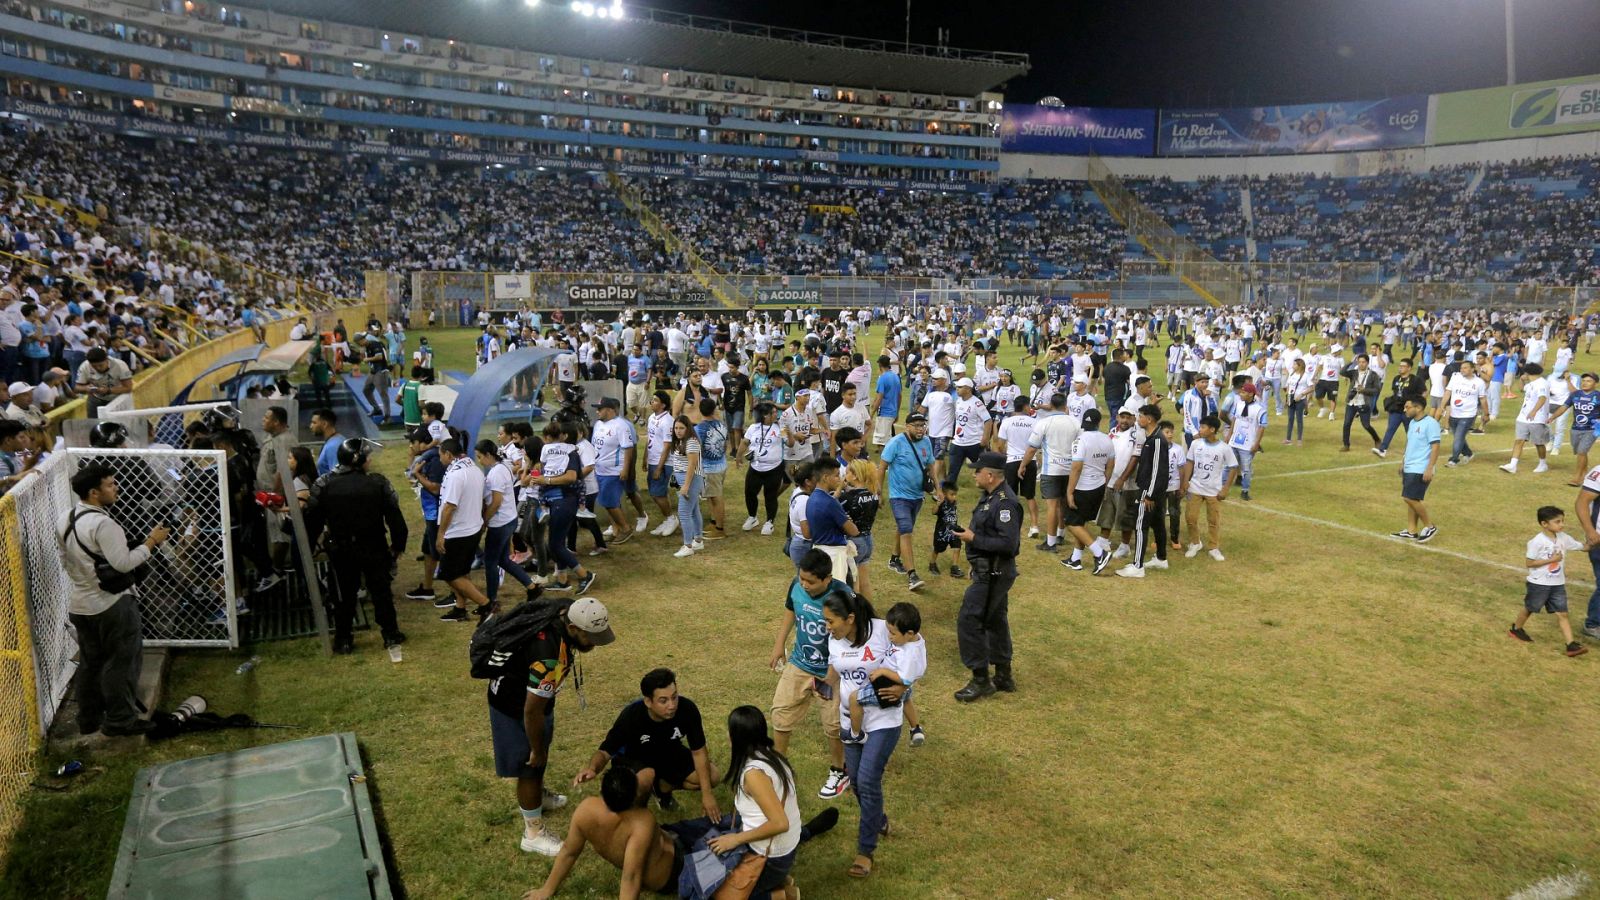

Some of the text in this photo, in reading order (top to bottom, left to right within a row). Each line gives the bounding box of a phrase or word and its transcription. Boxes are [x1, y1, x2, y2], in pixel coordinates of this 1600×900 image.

[1021, 120, 1144, 140] SHERWIN-WILLIAMS
[1172, 124, 1188, 136] La
[1190, 124, 1214, 136] Red
[1200, 136, 1232, 149] Goles
[569, 285, 638, 299] GanaPlay
[686, 293, 706, 302] 2023
[770, 290, 818, 300] ACODJAR
[1574, 402, 1594, 411] tigo
[861, 645, 877, 662] A
[840, 667, 867, 681] tigo
[670, 726, 684, 740] A
